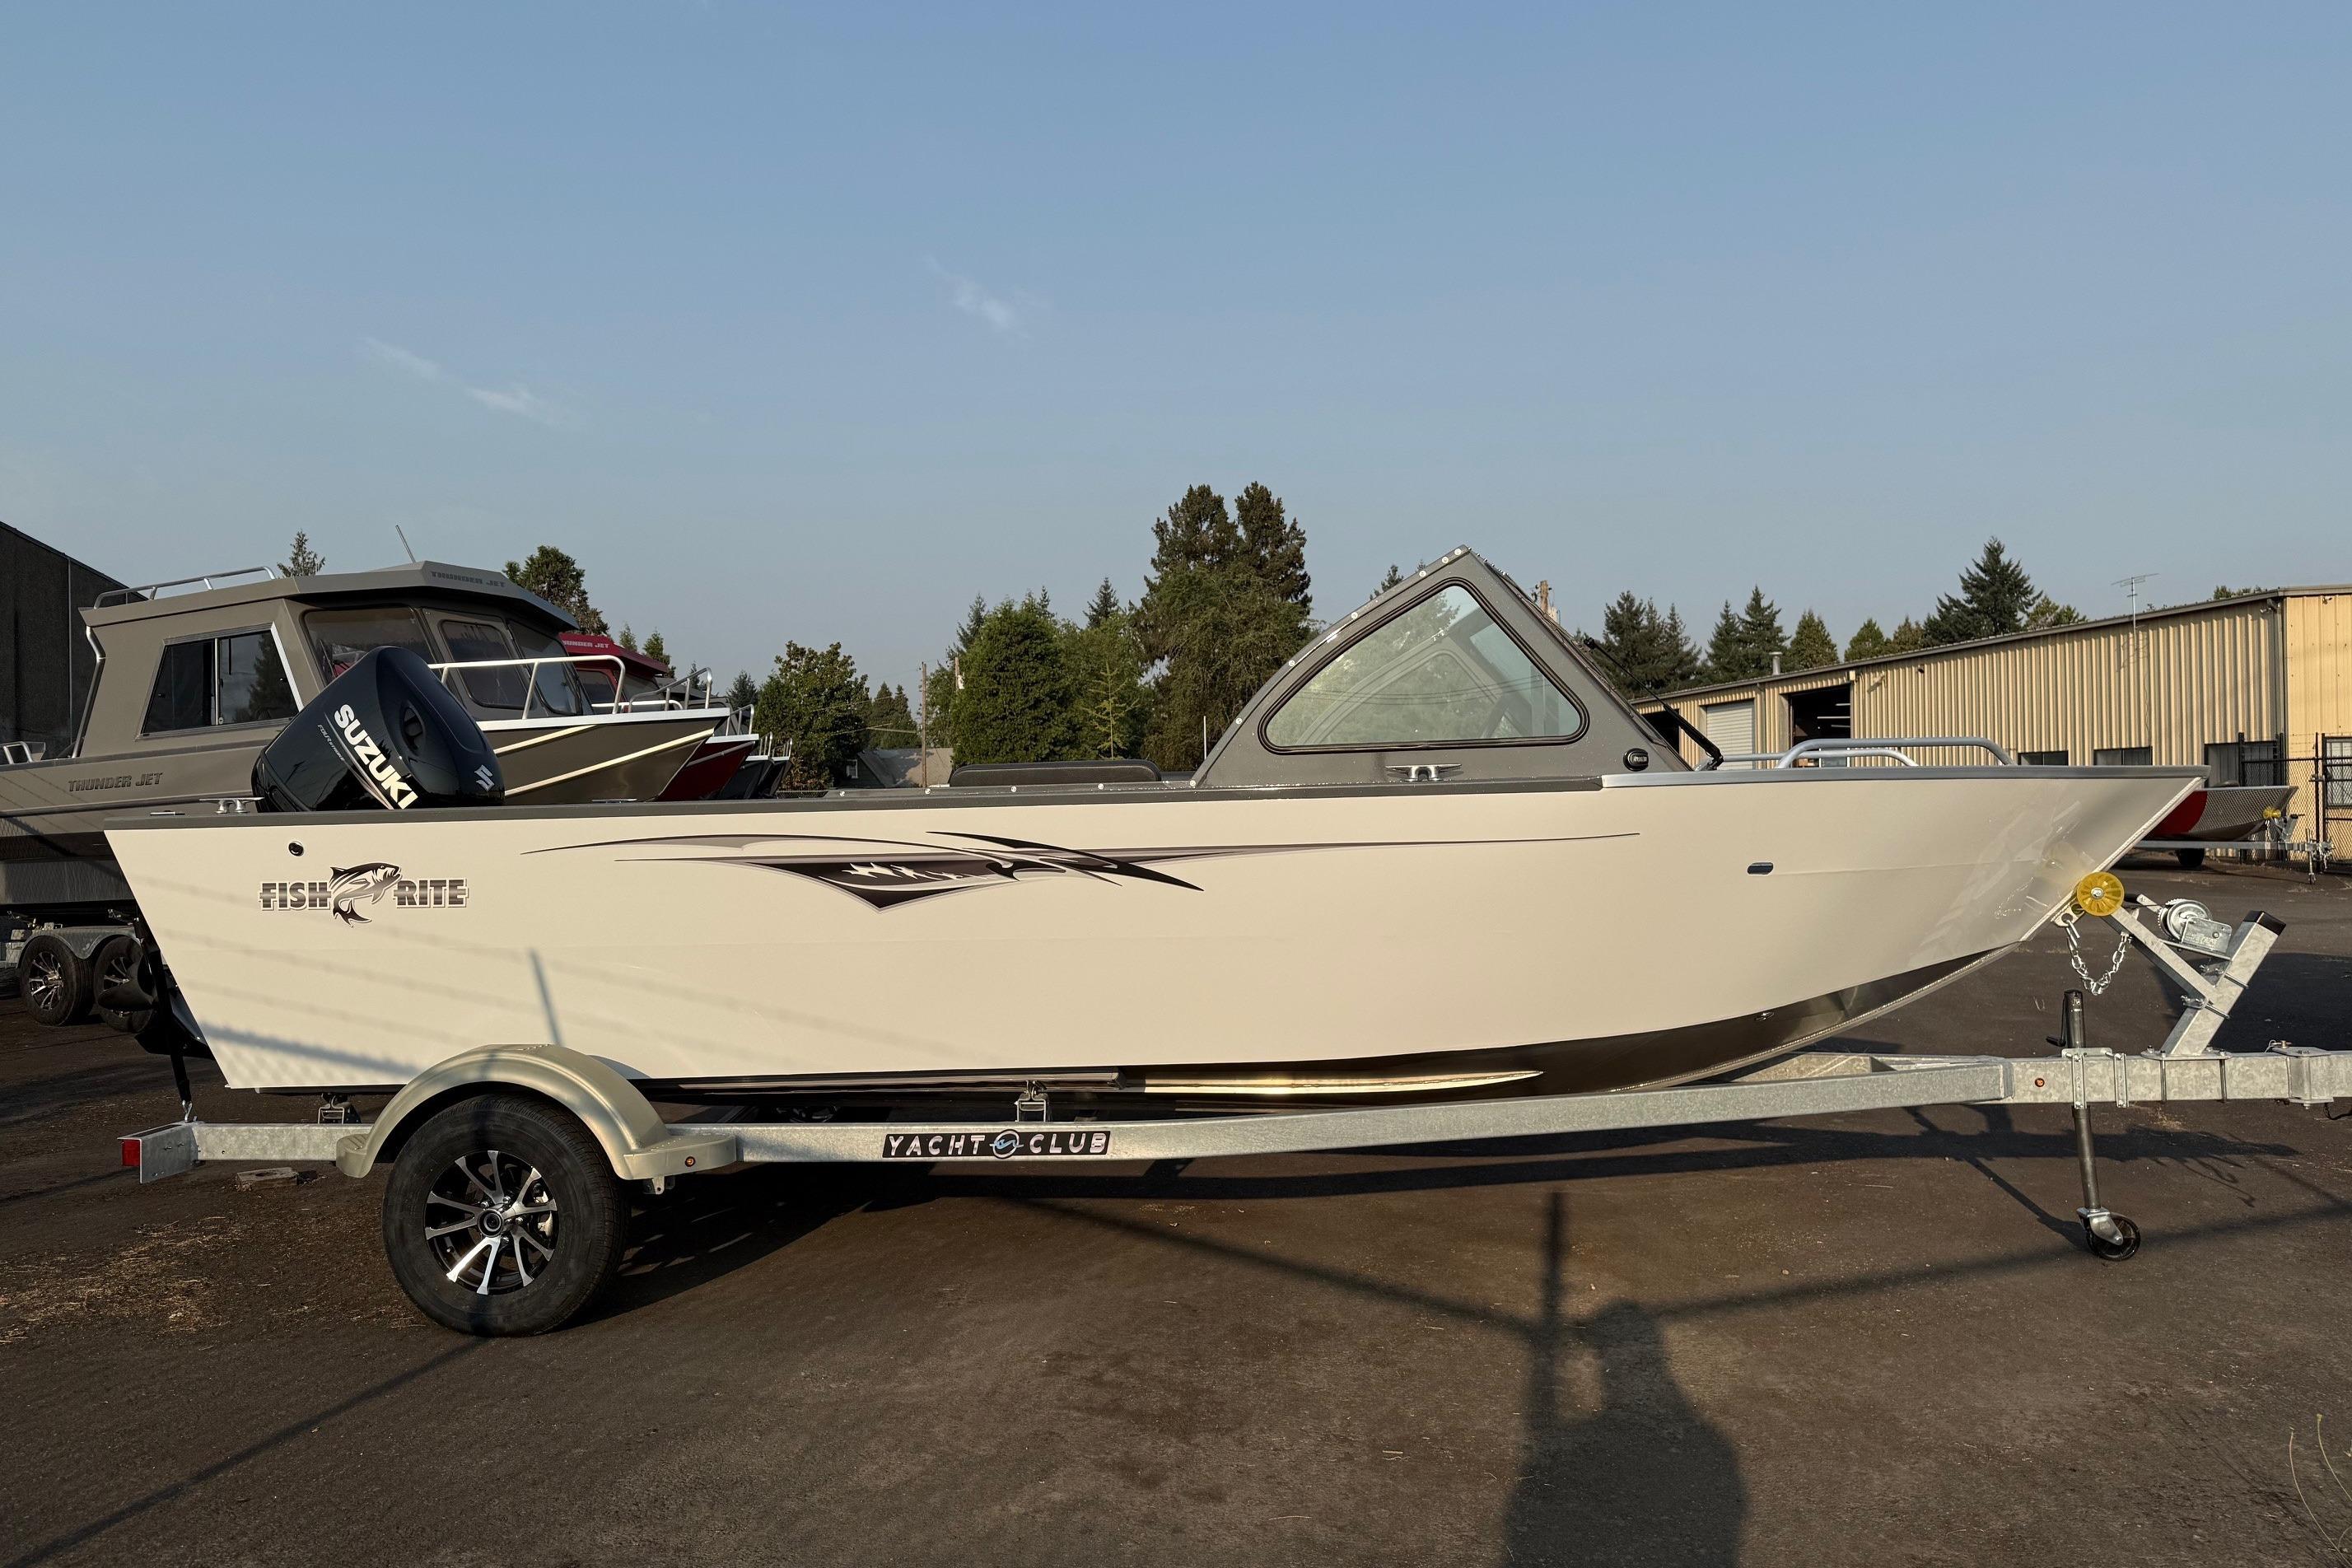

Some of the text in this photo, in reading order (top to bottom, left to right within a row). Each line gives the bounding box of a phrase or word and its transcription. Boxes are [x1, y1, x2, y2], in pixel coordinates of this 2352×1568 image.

[486, 579, 506, 587] JET
[317, 724, 332, 742] FOUR
[334, 704, 418, 810] SUZUKI
[68, 772, 163, 791] THUNDER JET
[259, 878, 469, 910] FISH RITE
[889, 1133, 1107, 1156] YACHT CLUB
